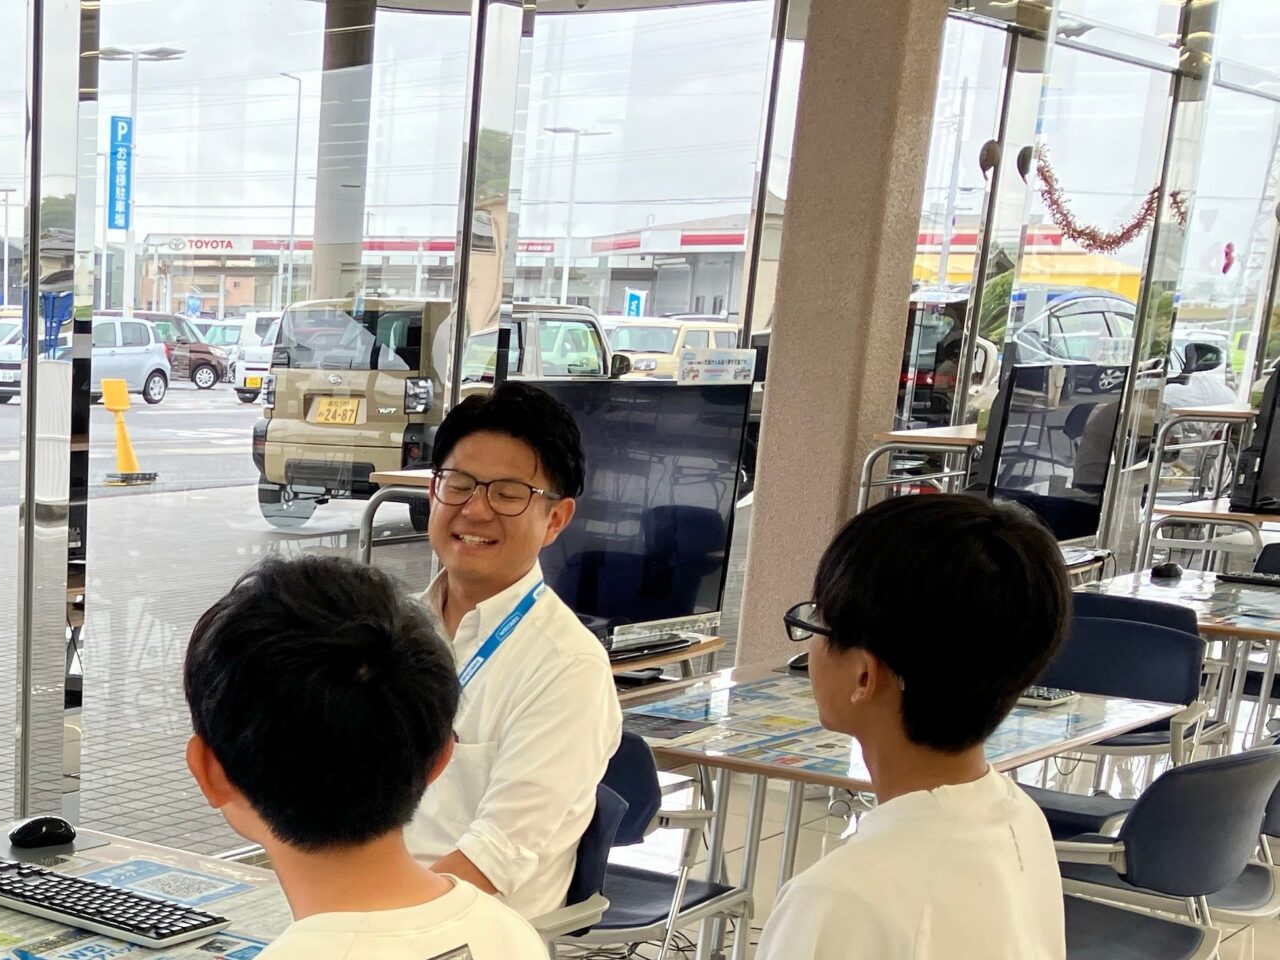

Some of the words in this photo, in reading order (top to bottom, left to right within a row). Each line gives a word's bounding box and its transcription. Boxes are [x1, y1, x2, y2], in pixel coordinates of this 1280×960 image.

[117, 121, 128, 141] P
[188, 239, 234, 250] TOYOTA
[324, 409, 355, 422] 24-87
